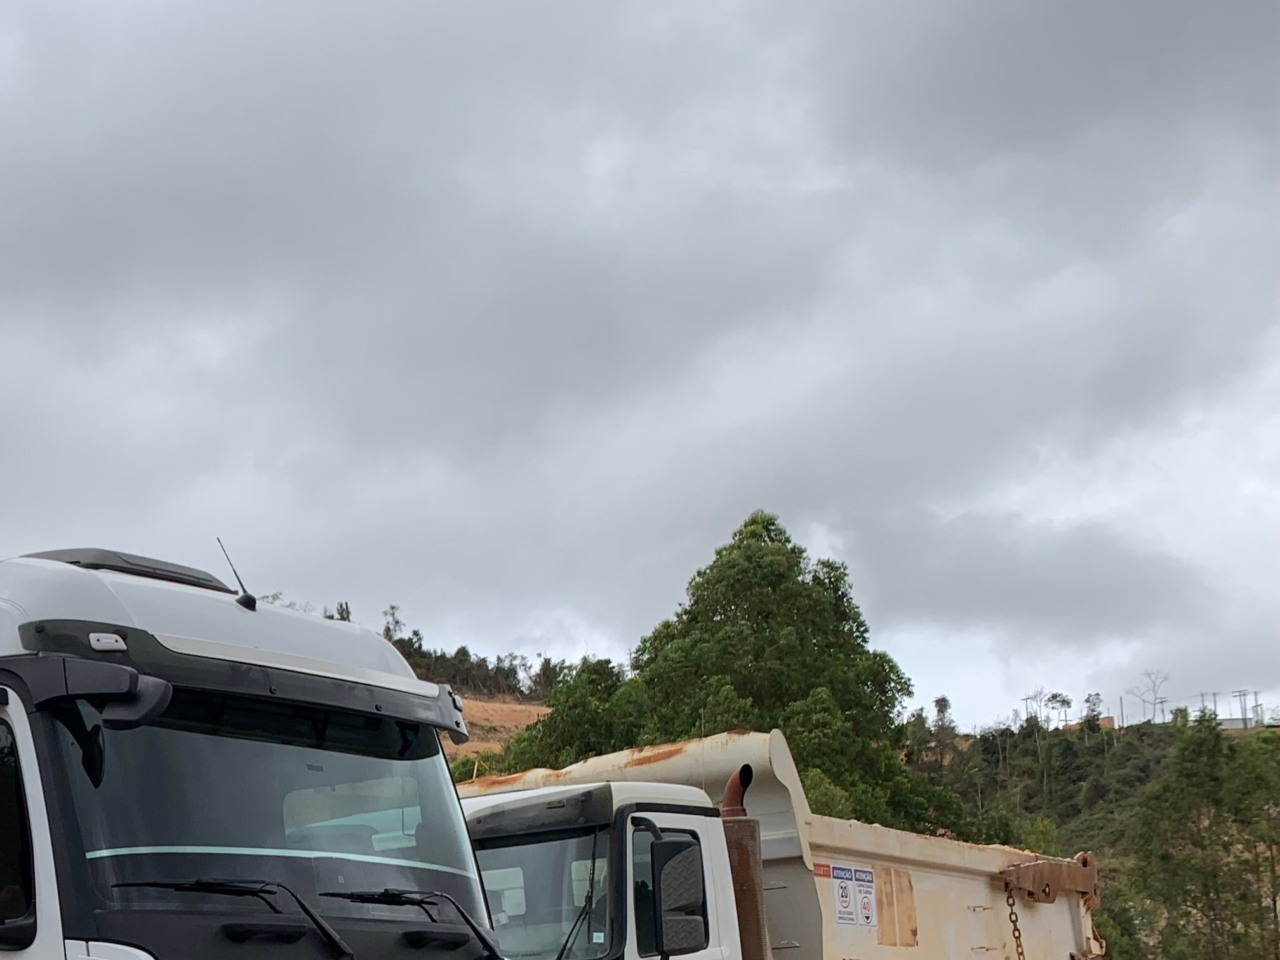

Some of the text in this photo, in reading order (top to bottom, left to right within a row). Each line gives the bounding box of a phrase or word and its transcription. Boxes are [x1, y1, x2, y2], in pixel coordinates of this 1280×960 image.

[833, 868, 852, 879] ATENÇÃO
[855, 870, 873, 881] ATENÇÃO
[840, 885, 848, 898] 20
[862, 901, 870, 912] 40
